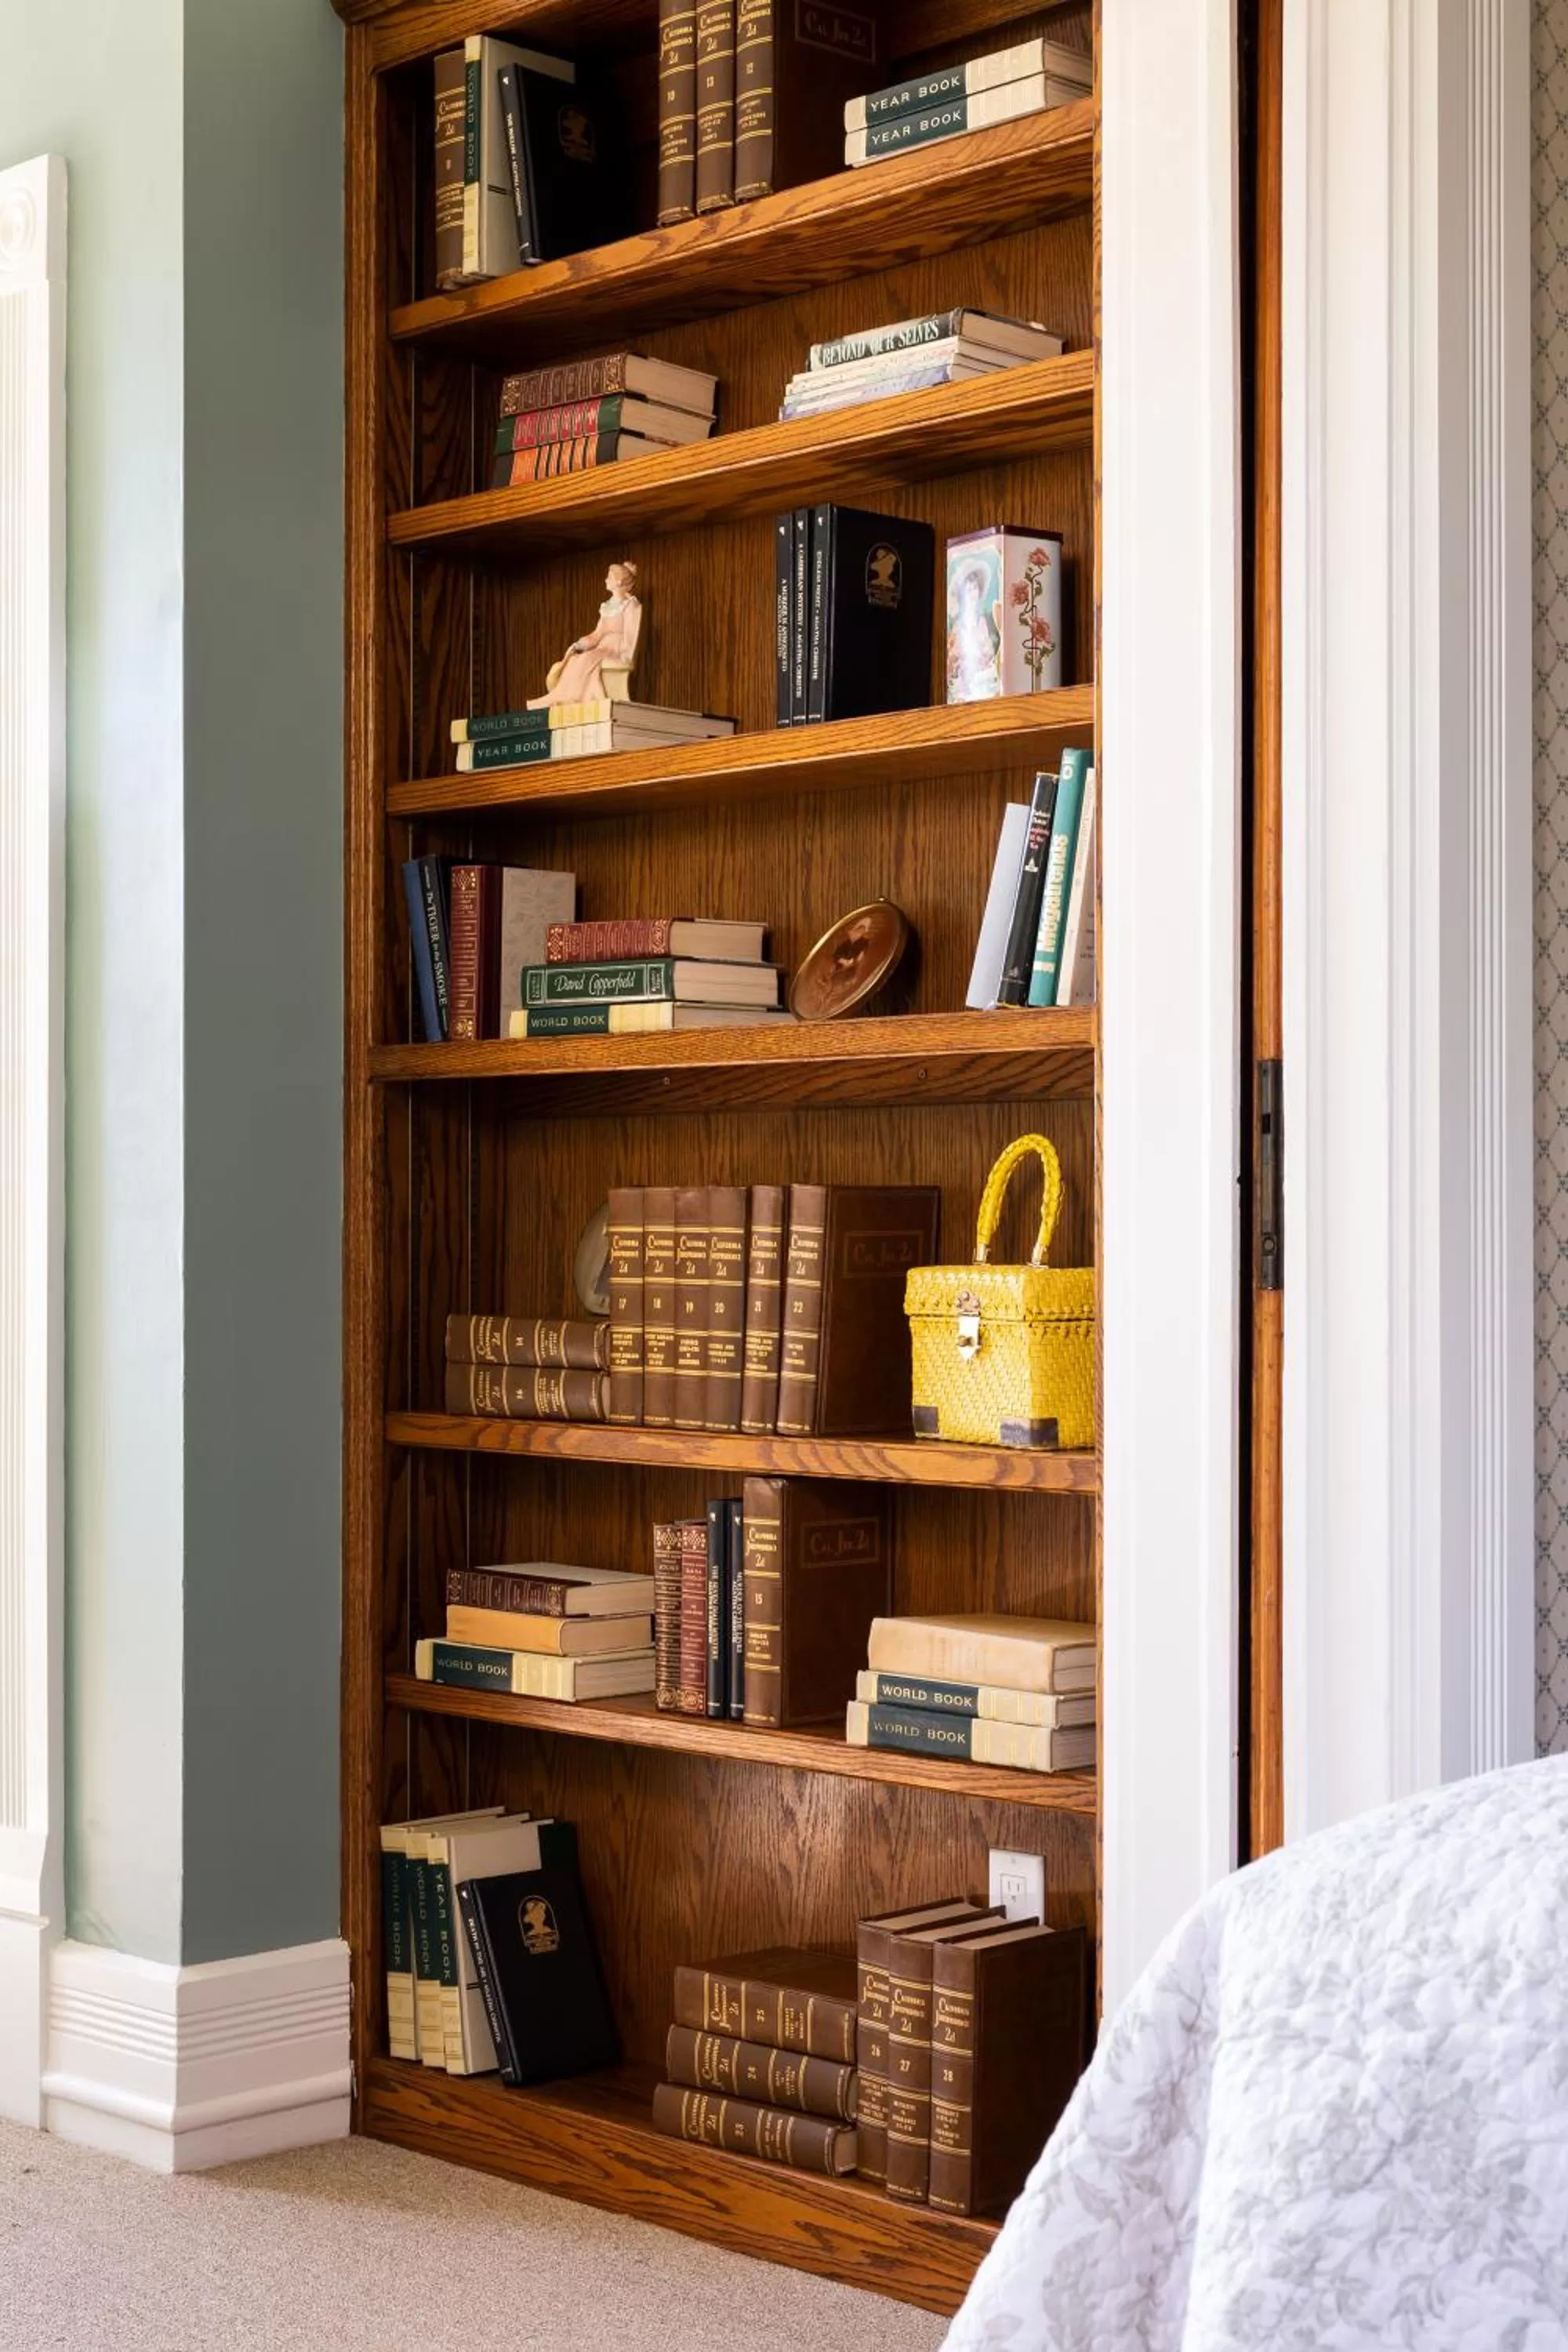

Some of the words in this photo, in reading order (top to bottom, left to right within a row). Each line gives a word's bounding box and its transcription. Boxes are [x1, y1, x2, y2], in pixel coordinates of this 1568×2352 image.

[466, 68, 476, 123] WORLD
[869, 91, 909, 112] YEAR
[918, 75, 960, 99] BOOK
[872, 125, 911, 145] YEAR
[920, 108, 962, 132] BOOK
[823, 339, 865, 366] BEYOND
[899, 318, 939, 349] SELVES
[477, 746, 508, 759] YEAR
[514, 739, 547, 753] BOOK
[427, 903, 440, 943] TIGER
[434, 961, 448, 1006] SMOKE
[554, 972, 586, 992] David
[588, 971, 636, 996] Copperfield
[531, 1015, 568, 1028] WORLD
[573, 1014, 605, 1026] BOOK
[754, 1592, 764, 1605] 15
[437, 1659, 473, 1671] WORLD
[477, 1663, 509, 1677] BOOK
[880, 1684, 927, 1700] WORLD
[934, 1693, 972, 1708] BOOK
[874, 1721, 920, 1737] WORLD
[927, 1729, 966, 1744] BOOK
[416, 1865, 427, 1920] WORLD
[434, 1871, 447, 1920] YEAR
[391, 1918, 402, 1967] BOOK
[420, 1929, 430, 1975] BOOK
[439, 1930, 451, 1980] BOOK
[901, 2017, 913, 2033] 2d
[944, 2027, 956, 2042] 2d
[719, 2057, 730, 2073] 2d
